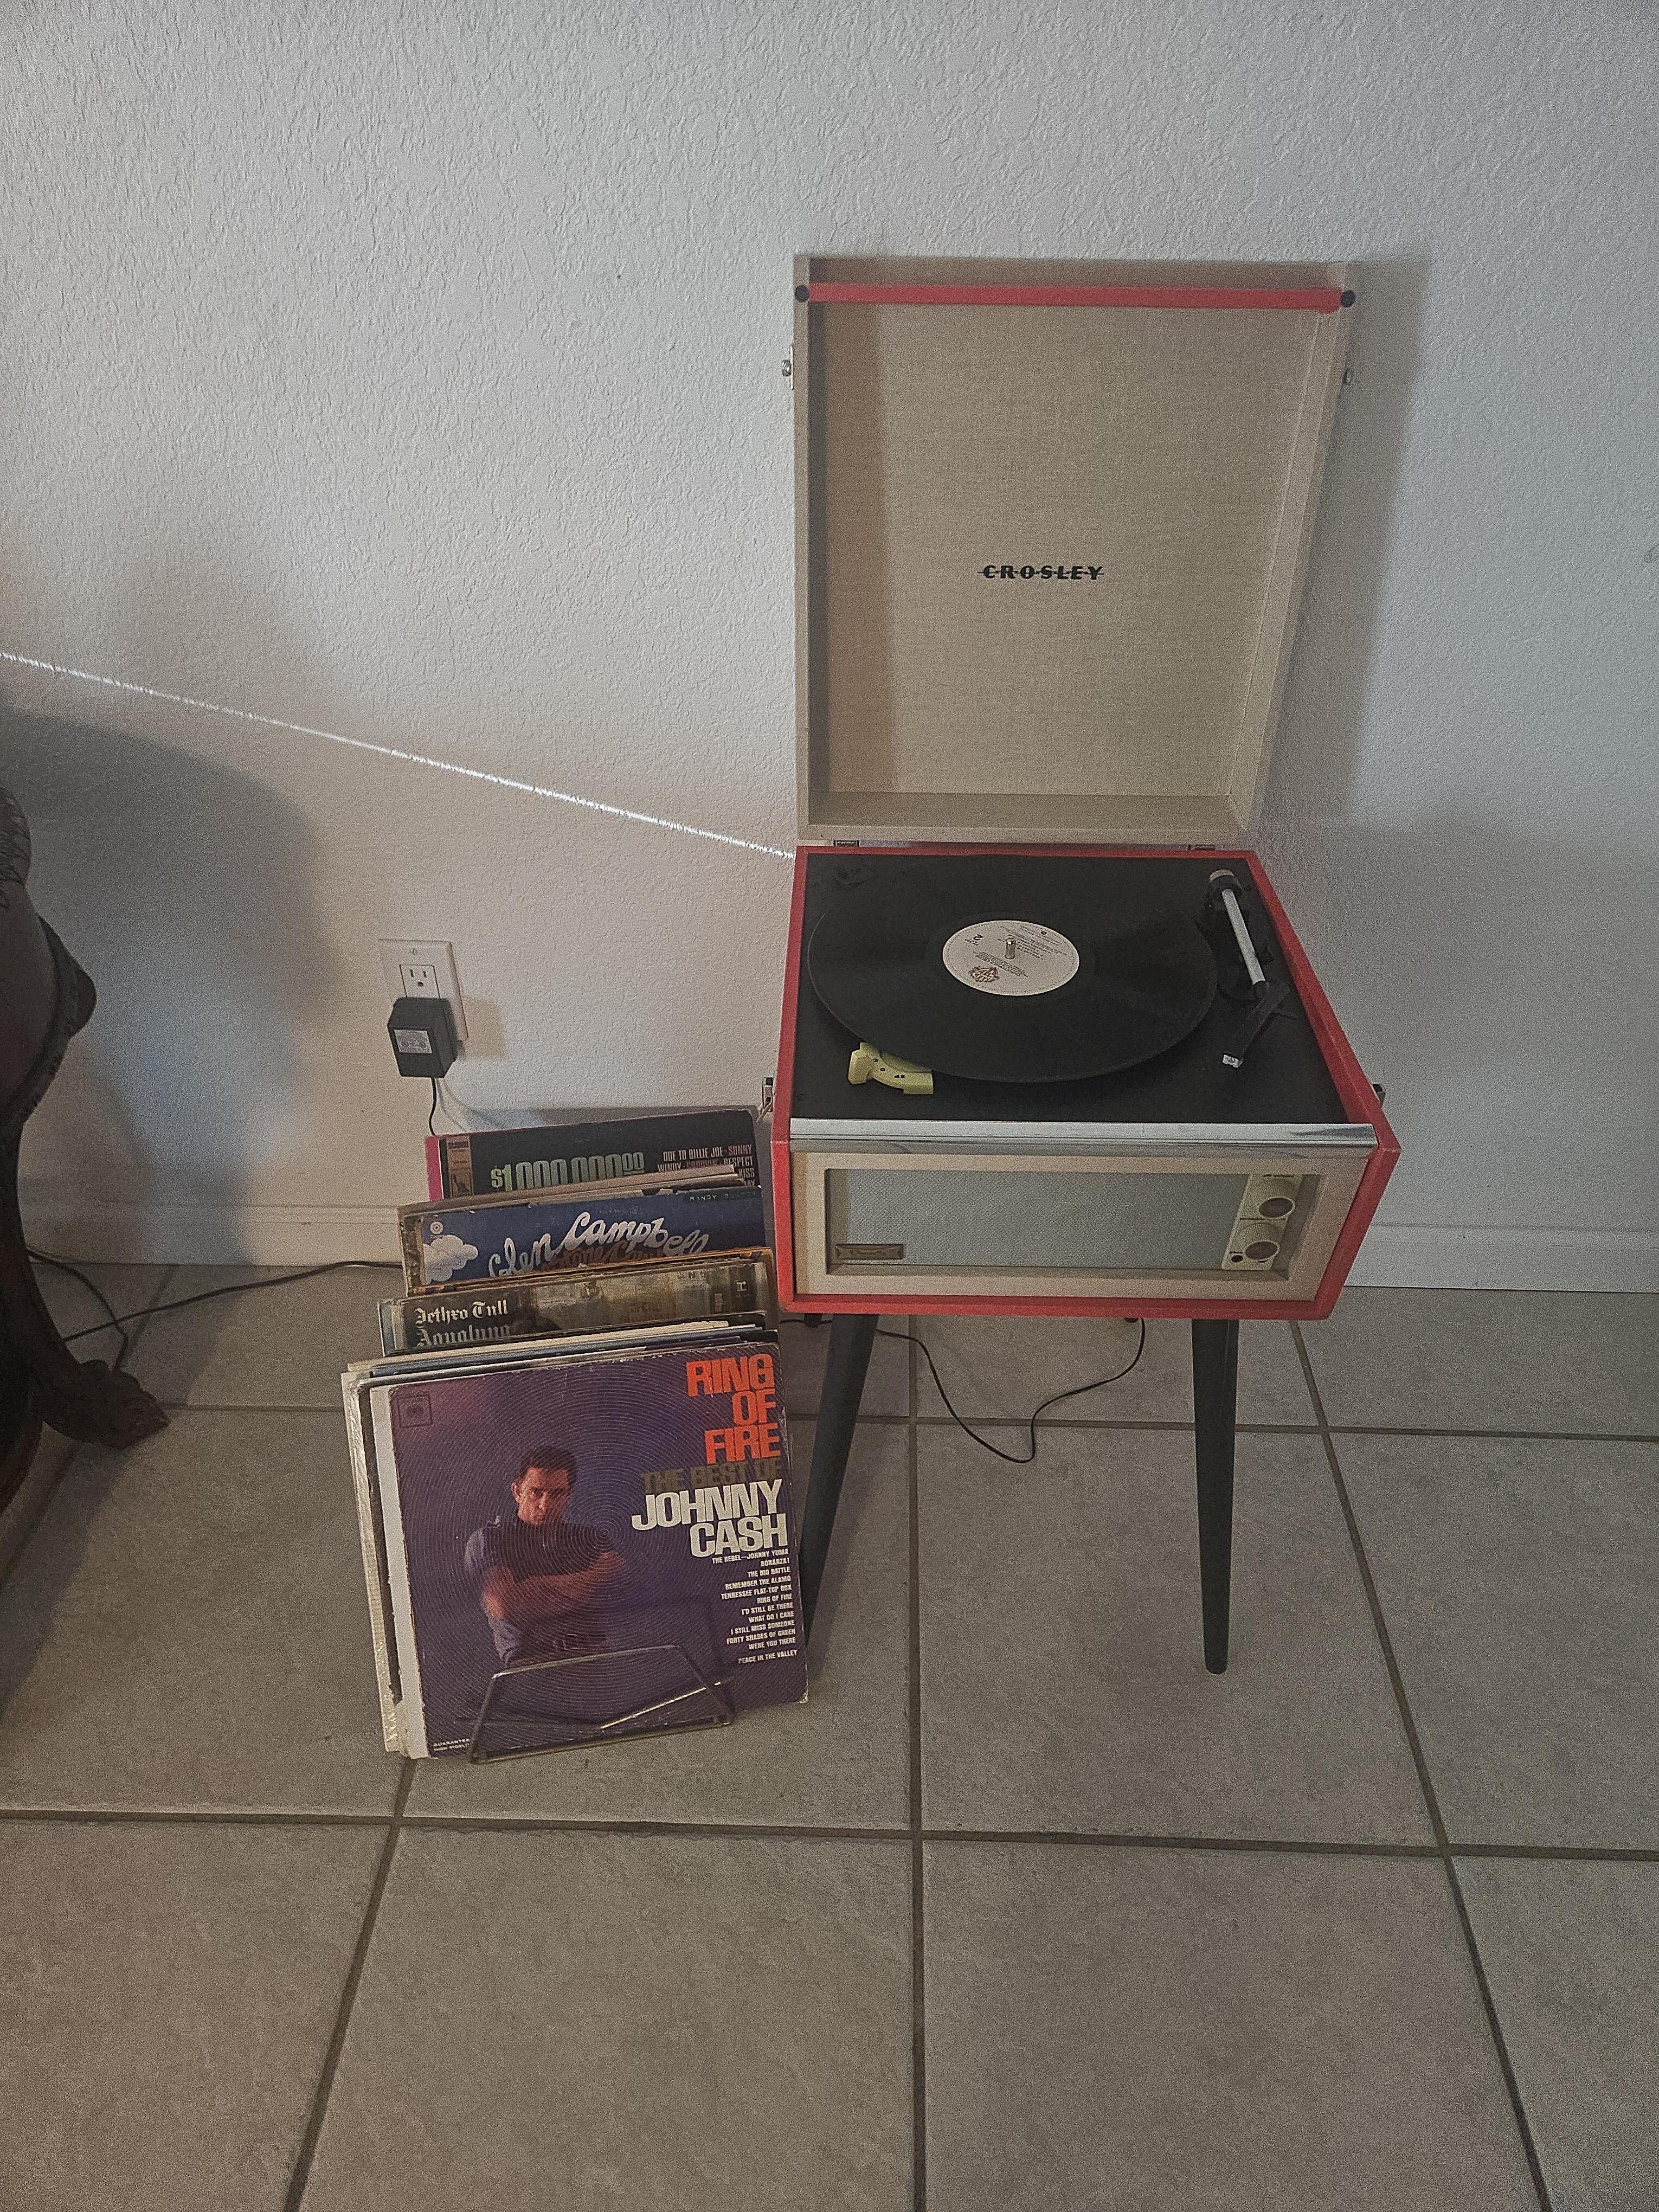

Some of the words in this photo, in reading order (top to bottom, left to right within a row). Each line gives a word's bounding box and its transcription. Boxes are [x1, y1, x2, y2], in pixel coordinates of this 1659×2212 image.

[980, 565, 1104, 580] CROSLEY
[663, 1151, 676, 1162] ODE
[679, 1150, 686, 1160] TO
[689, 1148, 708, 1159] BILLIE
[711, 1147, 723, 1157] JOE
[728, 1144, 752, 1155] SUNNY
[658, 1162, 681, 1172] WINDY
[724, 1156, 754, 1167] RESPECT
[554, 1212, 709, 1256] Campbell
[414, 1307, 468, 1325] Jethro
[472, 1300, 508, 1319] Tull
[686, 1354, 775, 1397] RING
[732, 1388, 776, 1426] OF
[705, 1423, 781, 1464] FIRE
[632, 1478, 782, 1531] JOHNNY
[690, 1513, 788, 1558] CASH
[771, 1566, 791, 1575] BATTLE
[725, 1580, 758, 1590] REMEMBER
[771, 1575, 791, 1584] ALAMO
[721, 1590, 753, 1600] TENNESSEE
[754, 1586, 779, 1595] FLAT-TOP
[751, 1606, 767, 1614] STILL
[748, 1615, 765, 1623] WHAT
[751, 1624, 766, 1632] MISS
[768, 1619, 795, 1629] SOMEONE
[726, 1636, 744, 1645] FORTY
[745, 1632, 768, 1642] SHADES
[777, 1628, 796, 1636] GREEN
[748, 1641, 765, 1650] WERE
[779, 1637, 796, 1645] THERE
[777, 1649, 798, 1658] VALLEY
